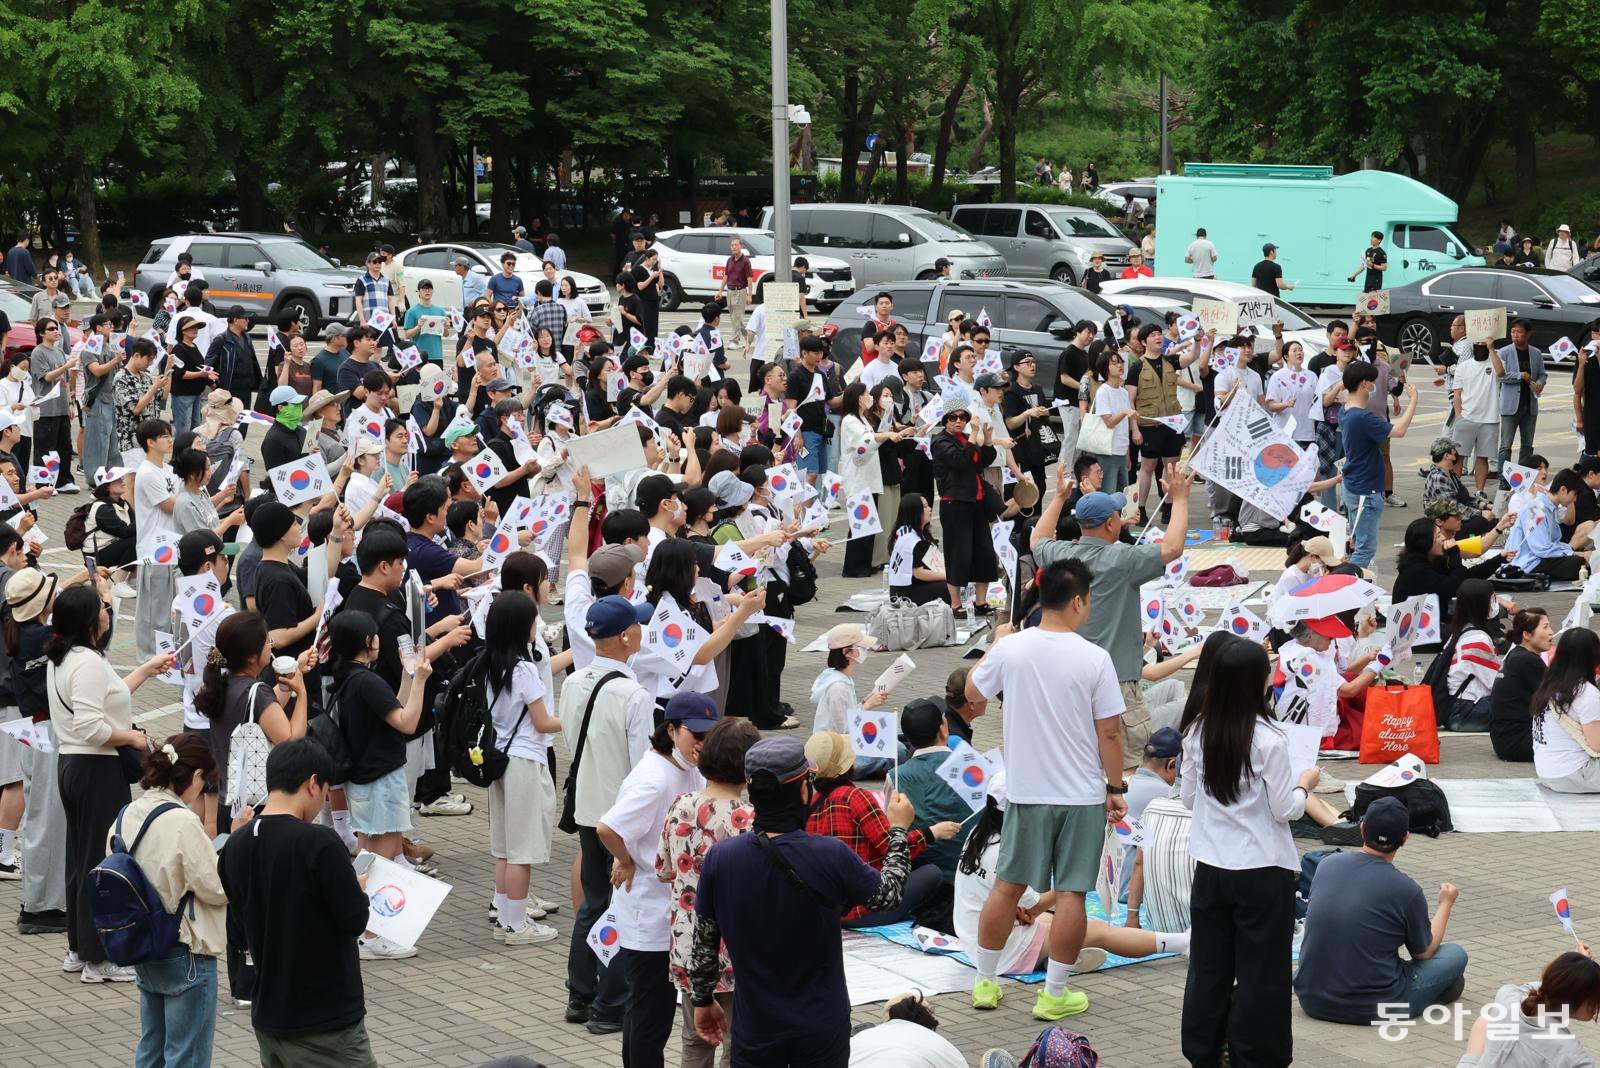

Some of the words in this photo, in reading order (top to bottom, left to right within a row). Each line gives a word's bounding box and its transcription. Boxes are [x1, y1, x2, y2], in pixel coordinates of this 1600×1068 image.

[235, 283, 263, 293] 서울신문
[1200, 303, 1230, 323] 재선거
[1238, 301, 1274, 319] 재선거
[1381, 713, 1414, 728] Happy
[1378, 727, 1416, 743] always
[1381, 741, 1409, 752] Here
